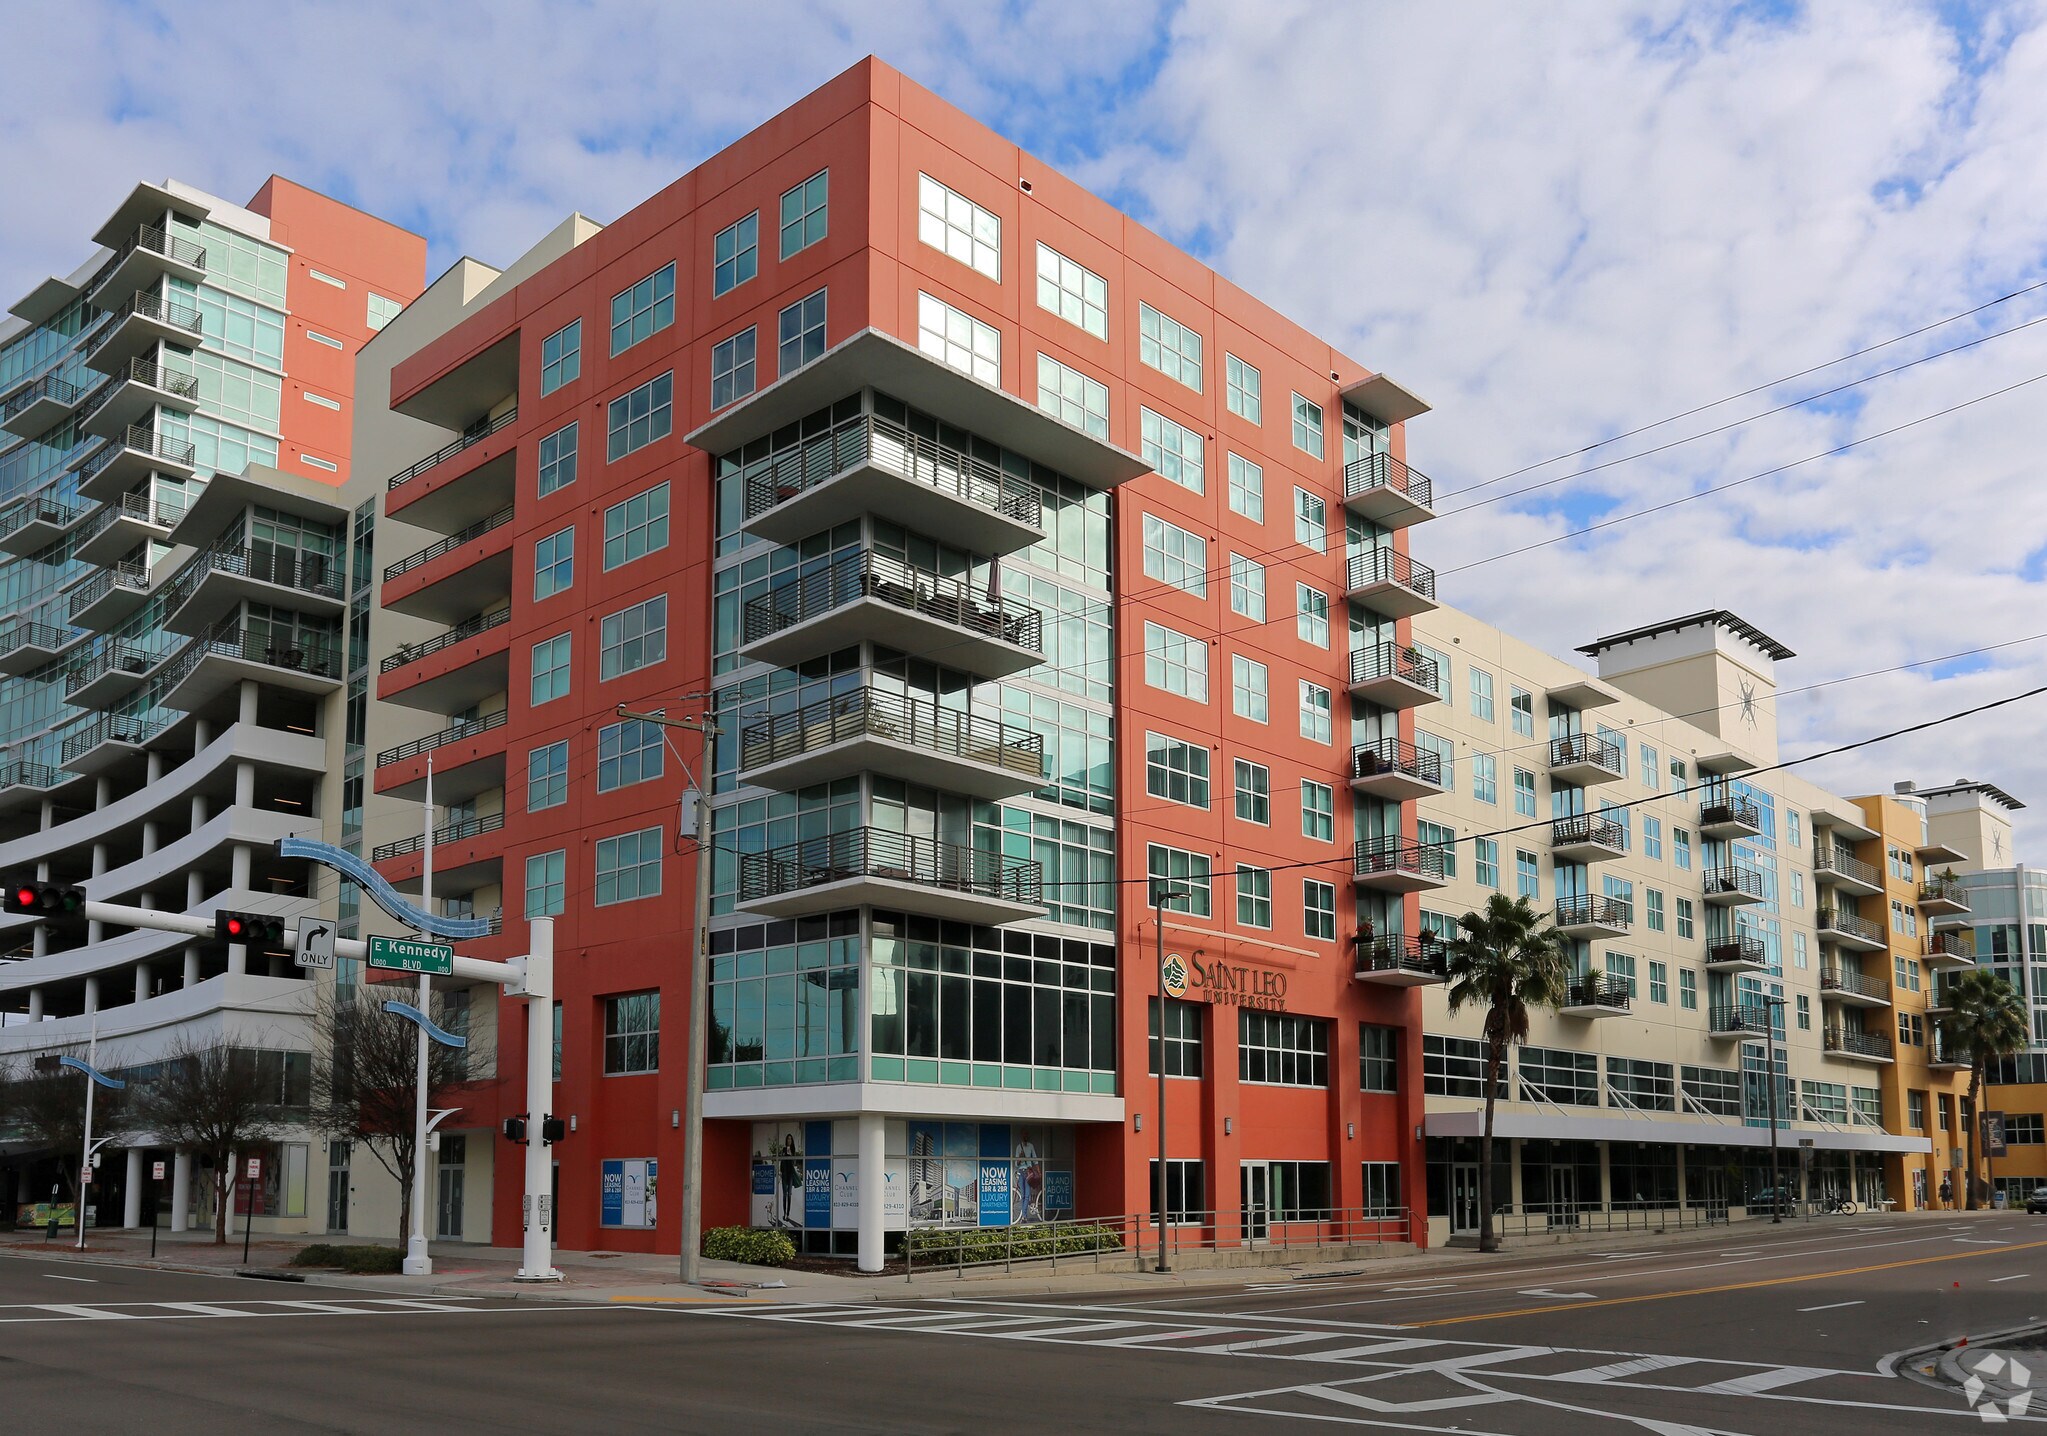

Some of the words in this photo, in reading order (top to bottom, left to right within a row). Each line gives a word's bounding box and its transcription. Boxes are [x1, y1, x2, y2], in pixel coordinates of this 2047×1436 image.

[375, 942, 382, 951] E
[389, 941, 448, 961] Kennedy
[301, 953, 328, 965] ONLY
[373, 958, 387, 966] 1000
[402, 960, 422, 970] BLVD
[1191, 949, 1249, 993] SAINT
[1252, 970, 1287, 998] LEO
[1203, 989, 1287, 1012] UNIVERSITY
[604, 1173, 622, 1183] NOW
[755, 1169, 774, 1178] HOME
[806, 1169, 830, 1180] NOW
[981, 1167, 1008, 1179] NOW
[981, 1178, 1007, 1186] LEASING
[1056, 1177, 1070, 1185] AND
[1046, 1186, 1070, 1194] ABOVE
[806, 1194, 830, 1202] LUXURY
[981, 1193, 1008, 1202] LUXURY
[1046, 1195, 1054, 1204] IT
[1055, 1195, 1070, 1205] ALL
